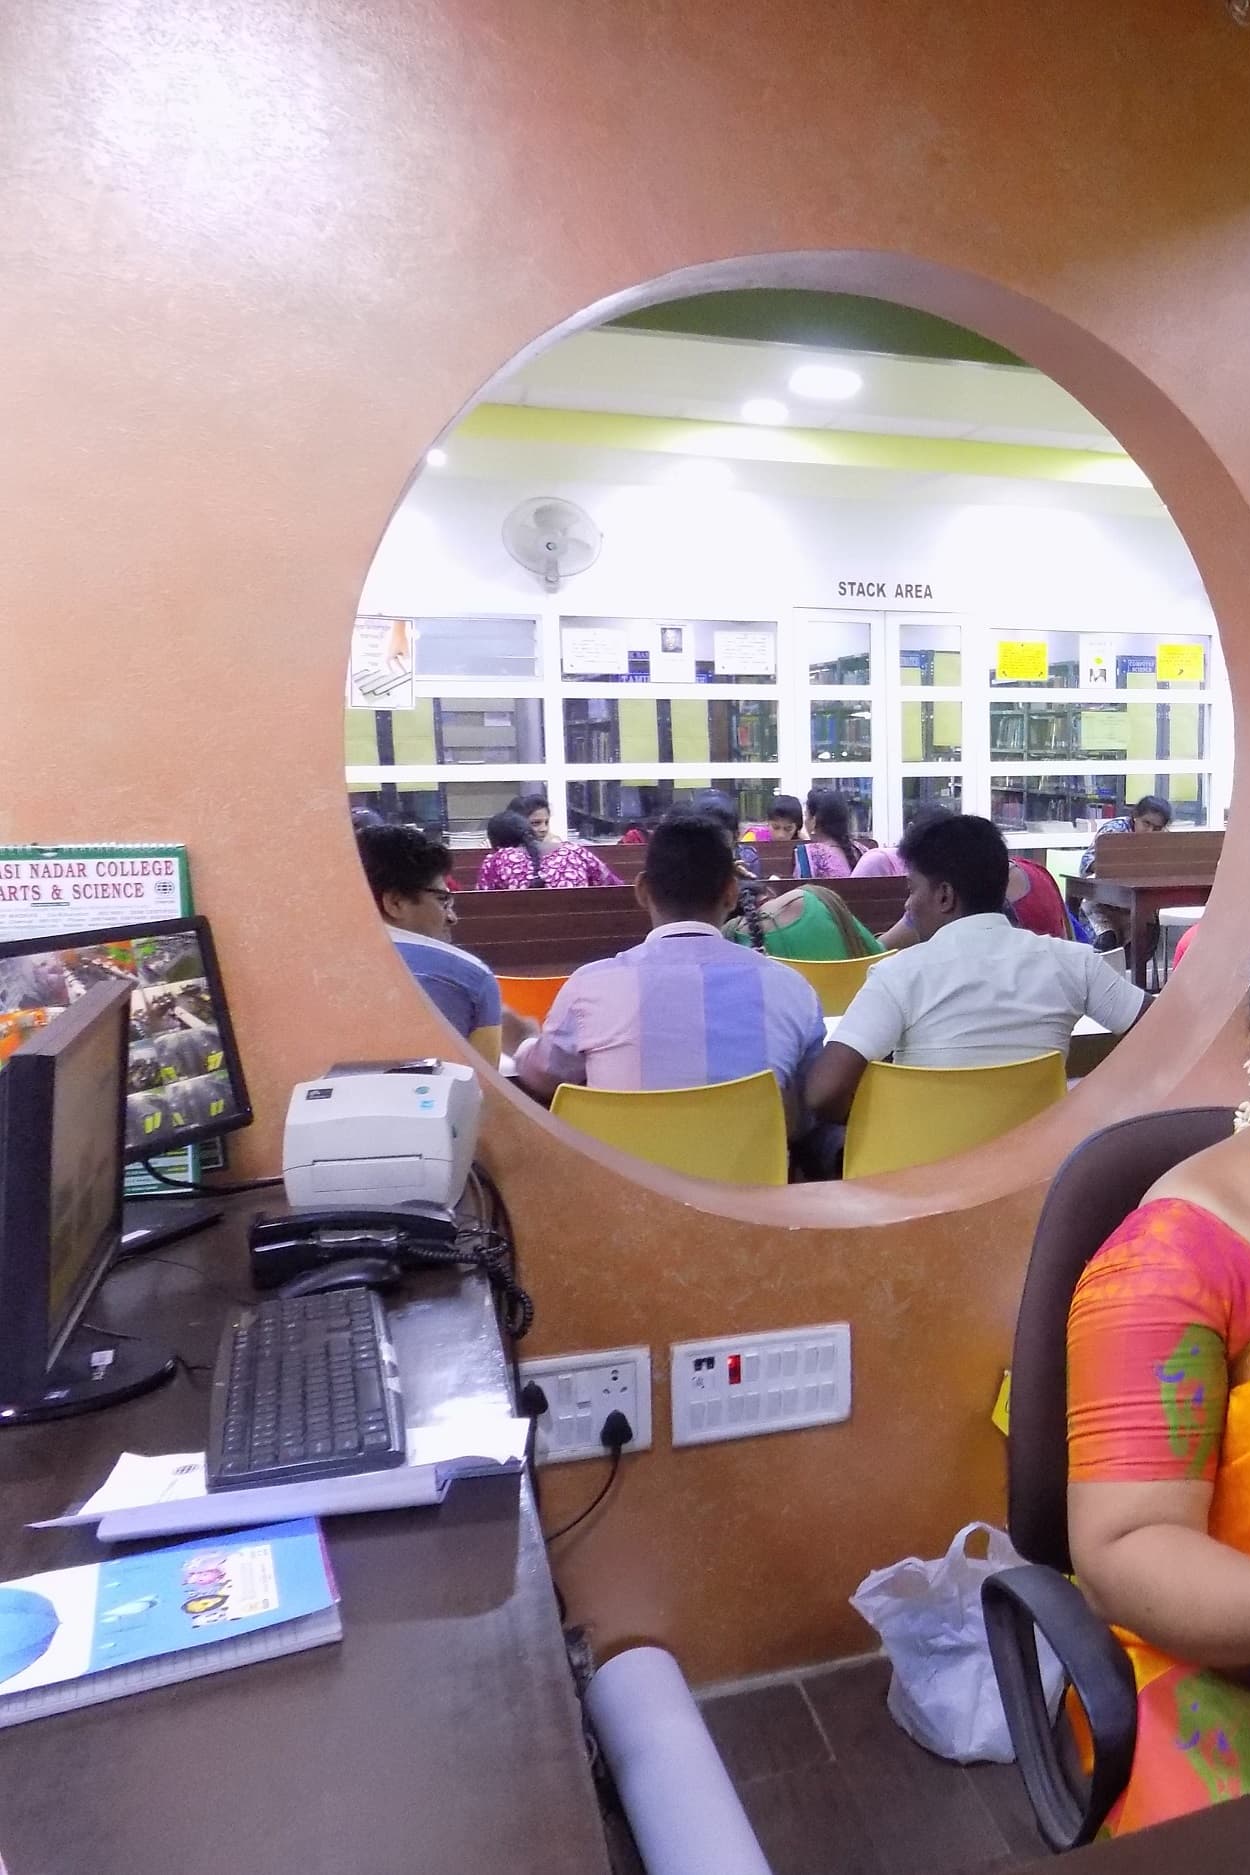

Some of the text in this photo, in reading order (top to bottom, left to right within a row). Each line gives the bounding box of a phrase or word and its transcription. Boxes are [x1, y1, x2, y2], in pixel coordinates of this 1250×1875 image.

[838, 581, 933, 599] STACK AREA
[0, 860, 174, 879] SI NADAR COLLEGE
[51, 885, 63, 900] &
[72, 883, 144, 900] SCIENCE
